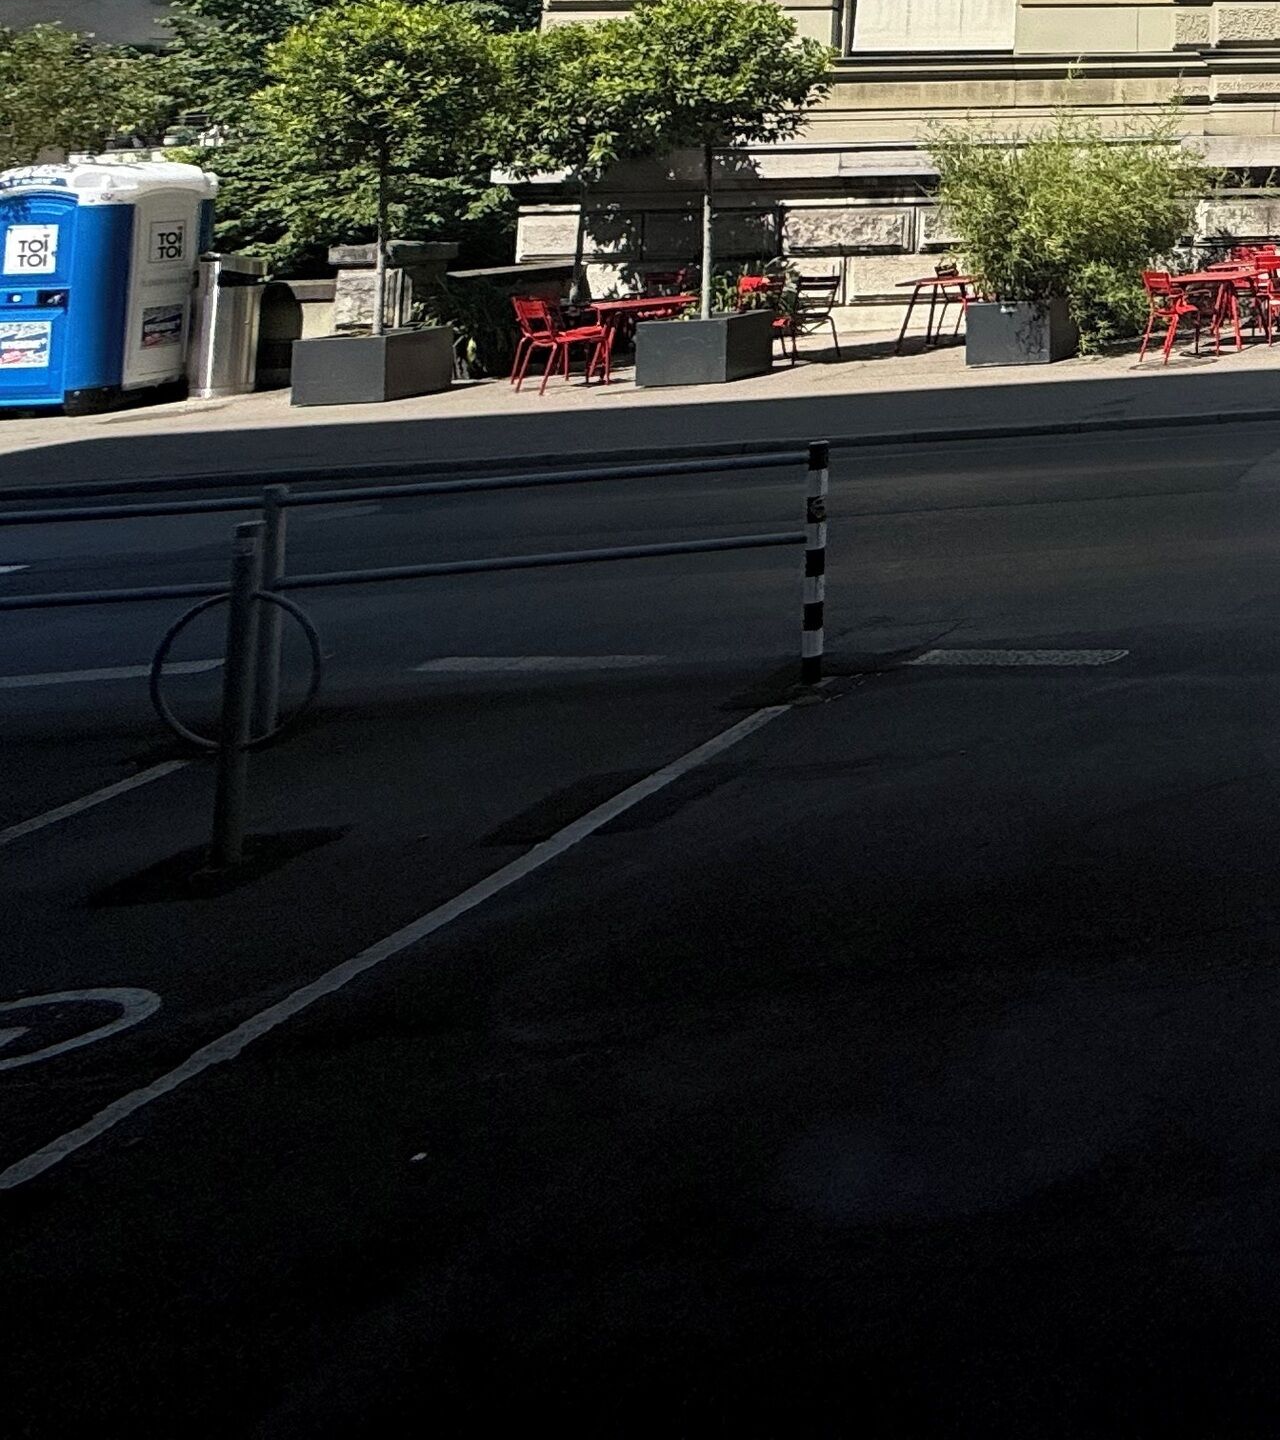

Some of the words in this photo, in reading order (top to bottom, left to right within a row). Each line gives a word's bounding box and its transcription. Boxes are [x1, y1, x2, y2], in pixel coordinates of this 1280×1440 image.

[157, 232, 183, 245] TOI
[18, 239, 49, 253] TOI
[157, 245, 182, 259] TOI
[17, 254, 47, 267] TOI
